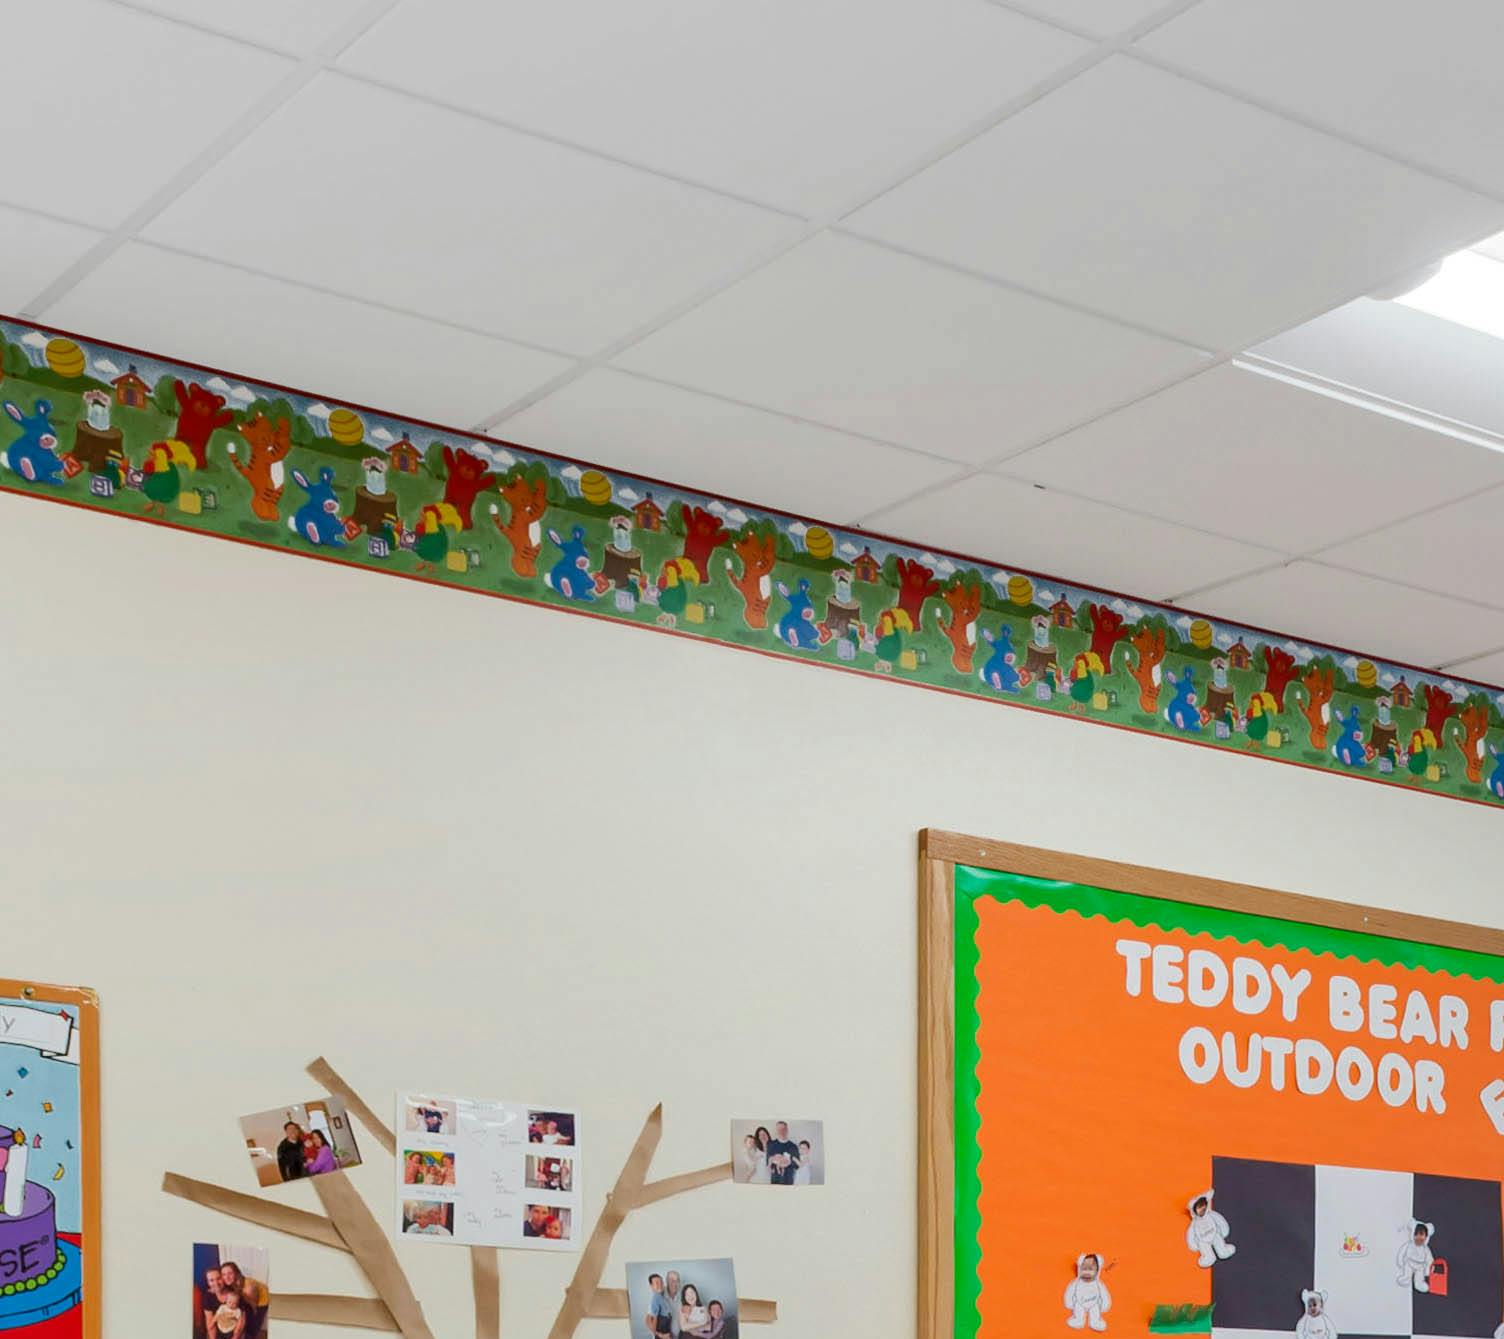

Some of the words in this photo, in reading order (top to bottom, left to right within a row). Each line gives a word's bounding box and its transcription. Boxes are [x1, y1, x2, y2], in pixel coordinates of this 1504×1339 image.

[1115, 939, 1311, 1022] TEDDY
[1328, 976, 1469, 1049] BEAR
[1178, 1026, 1446, 1114] OUTDOOR
